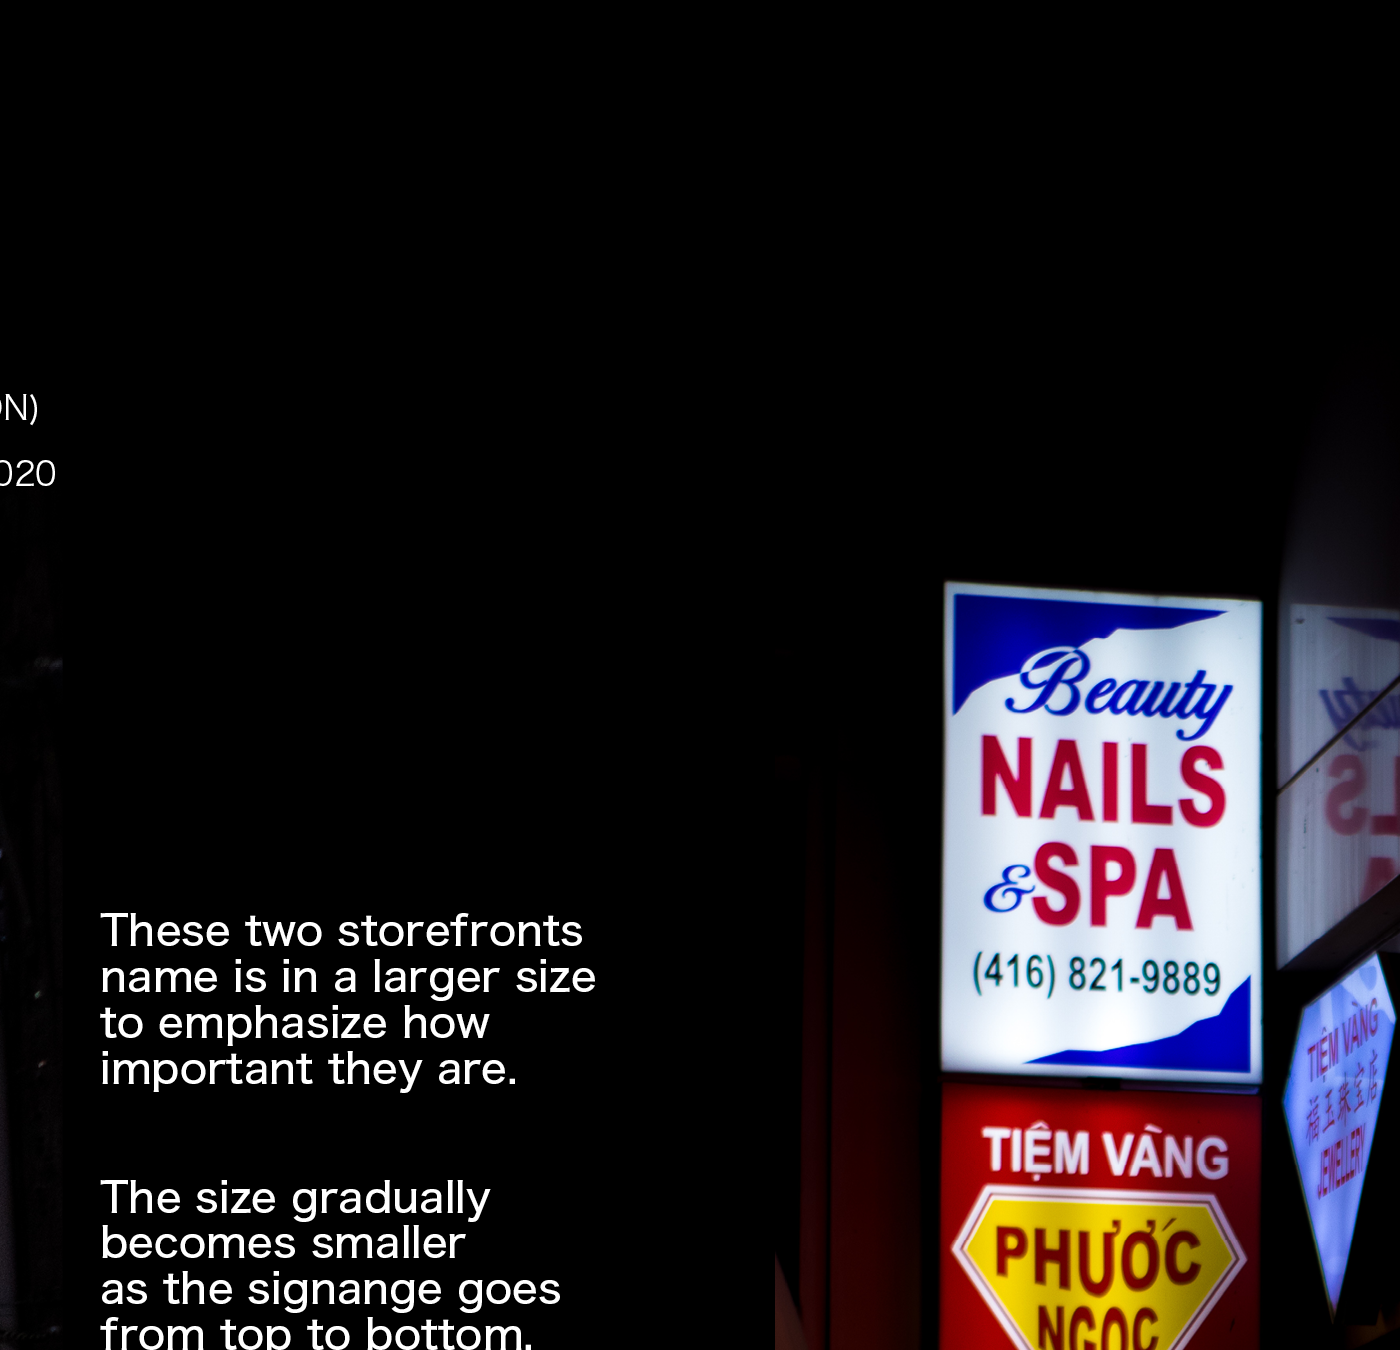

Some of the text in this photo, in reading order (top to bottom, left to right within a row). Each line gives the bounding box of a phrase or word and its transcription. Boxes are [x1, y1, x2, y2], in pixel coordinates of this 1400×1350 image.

[1005, 645, 1233, 741] Beauty
[980, 734, 1227, 829] NAILS
[972, 951, 1221, 998] (416) 821-9889
[1307, 998, 1379, 1083] TIỆM VÀNG
[981, 1120, 1231, 1183] TIỆM VÀNG
[1317, 1122, 1367, 1201] JEWELLERY
[995, 1217, 1202, 1296] PHƯỚC
